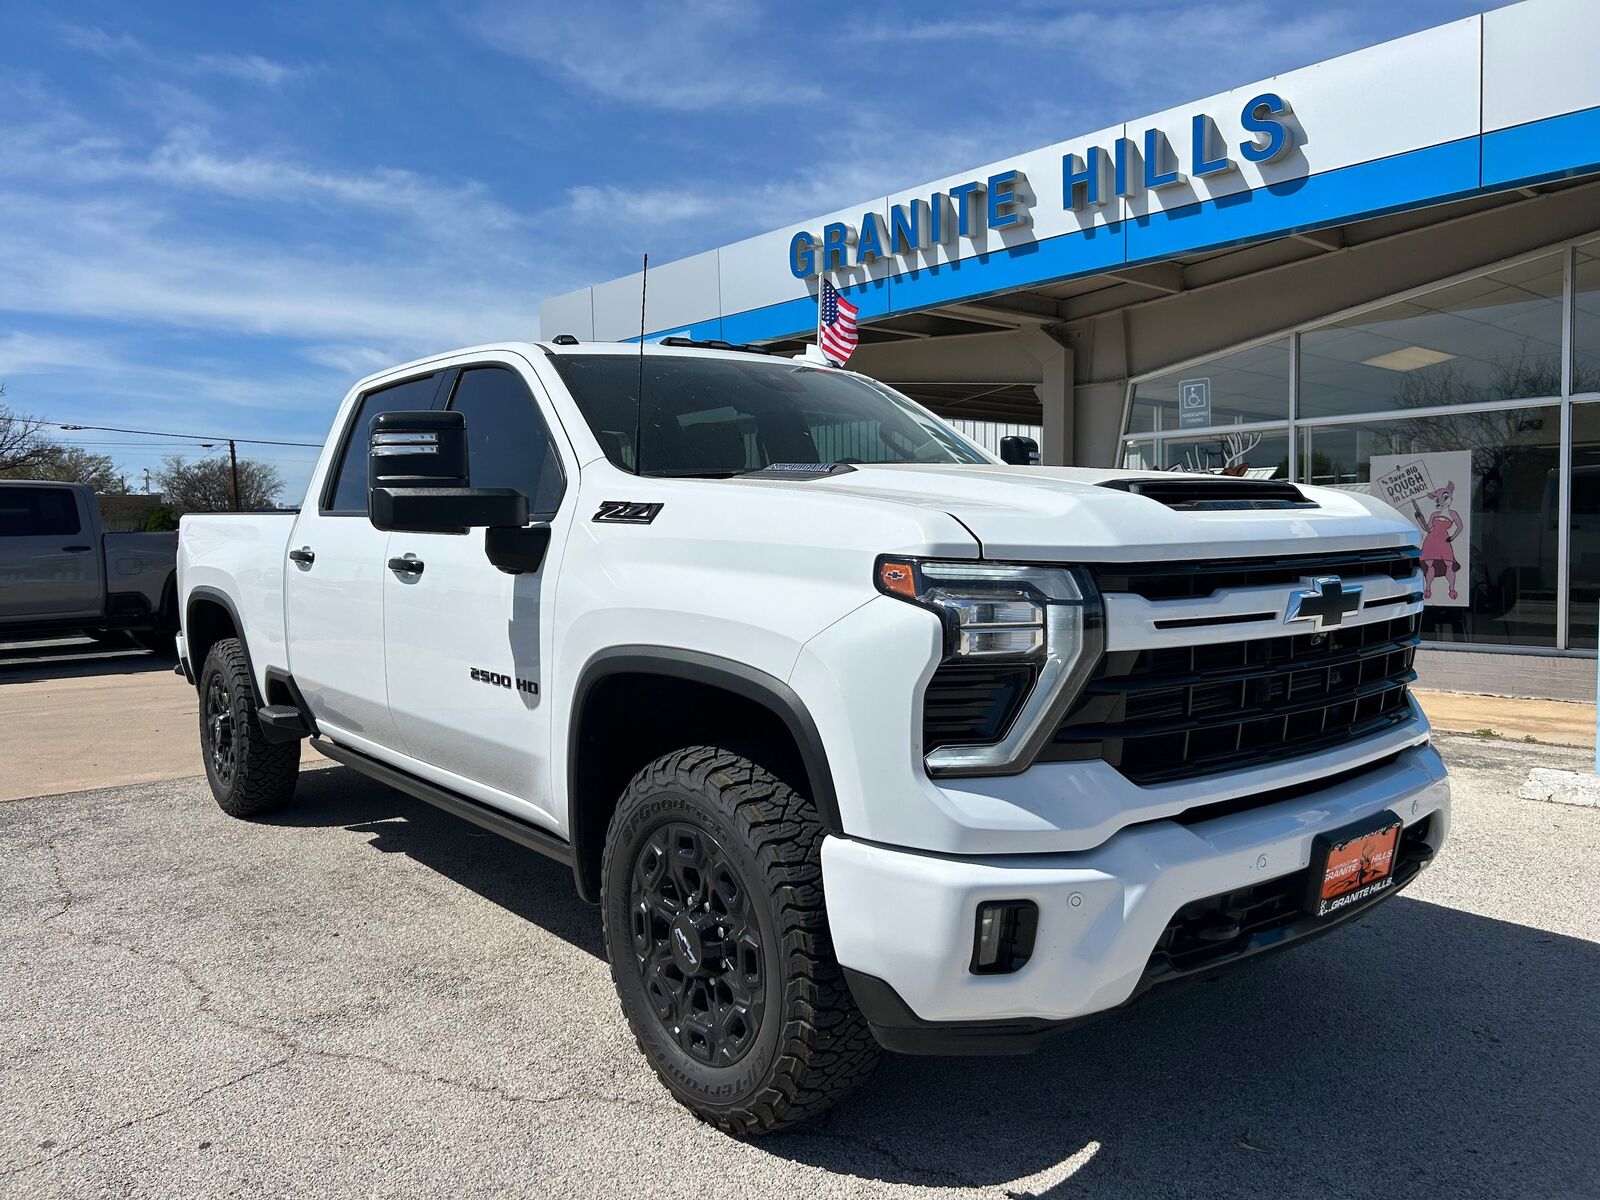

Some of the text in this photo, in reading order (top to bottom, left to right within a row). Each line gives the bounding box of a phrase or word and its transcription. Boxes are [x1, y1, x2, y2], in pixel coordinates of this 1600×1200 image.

[789, 92, 1289, 281] GRANITE HILLS
[1386, 472, 1424, 497] DOUGH
[1388, 466, 1417, 484] Save BIG
[1400, 482, 1428, 500] LLANO!
[591, 500, 664, 525] Z71
[470, 667, 539, 695] 2500 HD
[622, 798, 728, 847] BFGoodrich
[1371, 849, 1393, 864] HILLS
[1331, 877, 1392, 909] GRANITE HILLS
